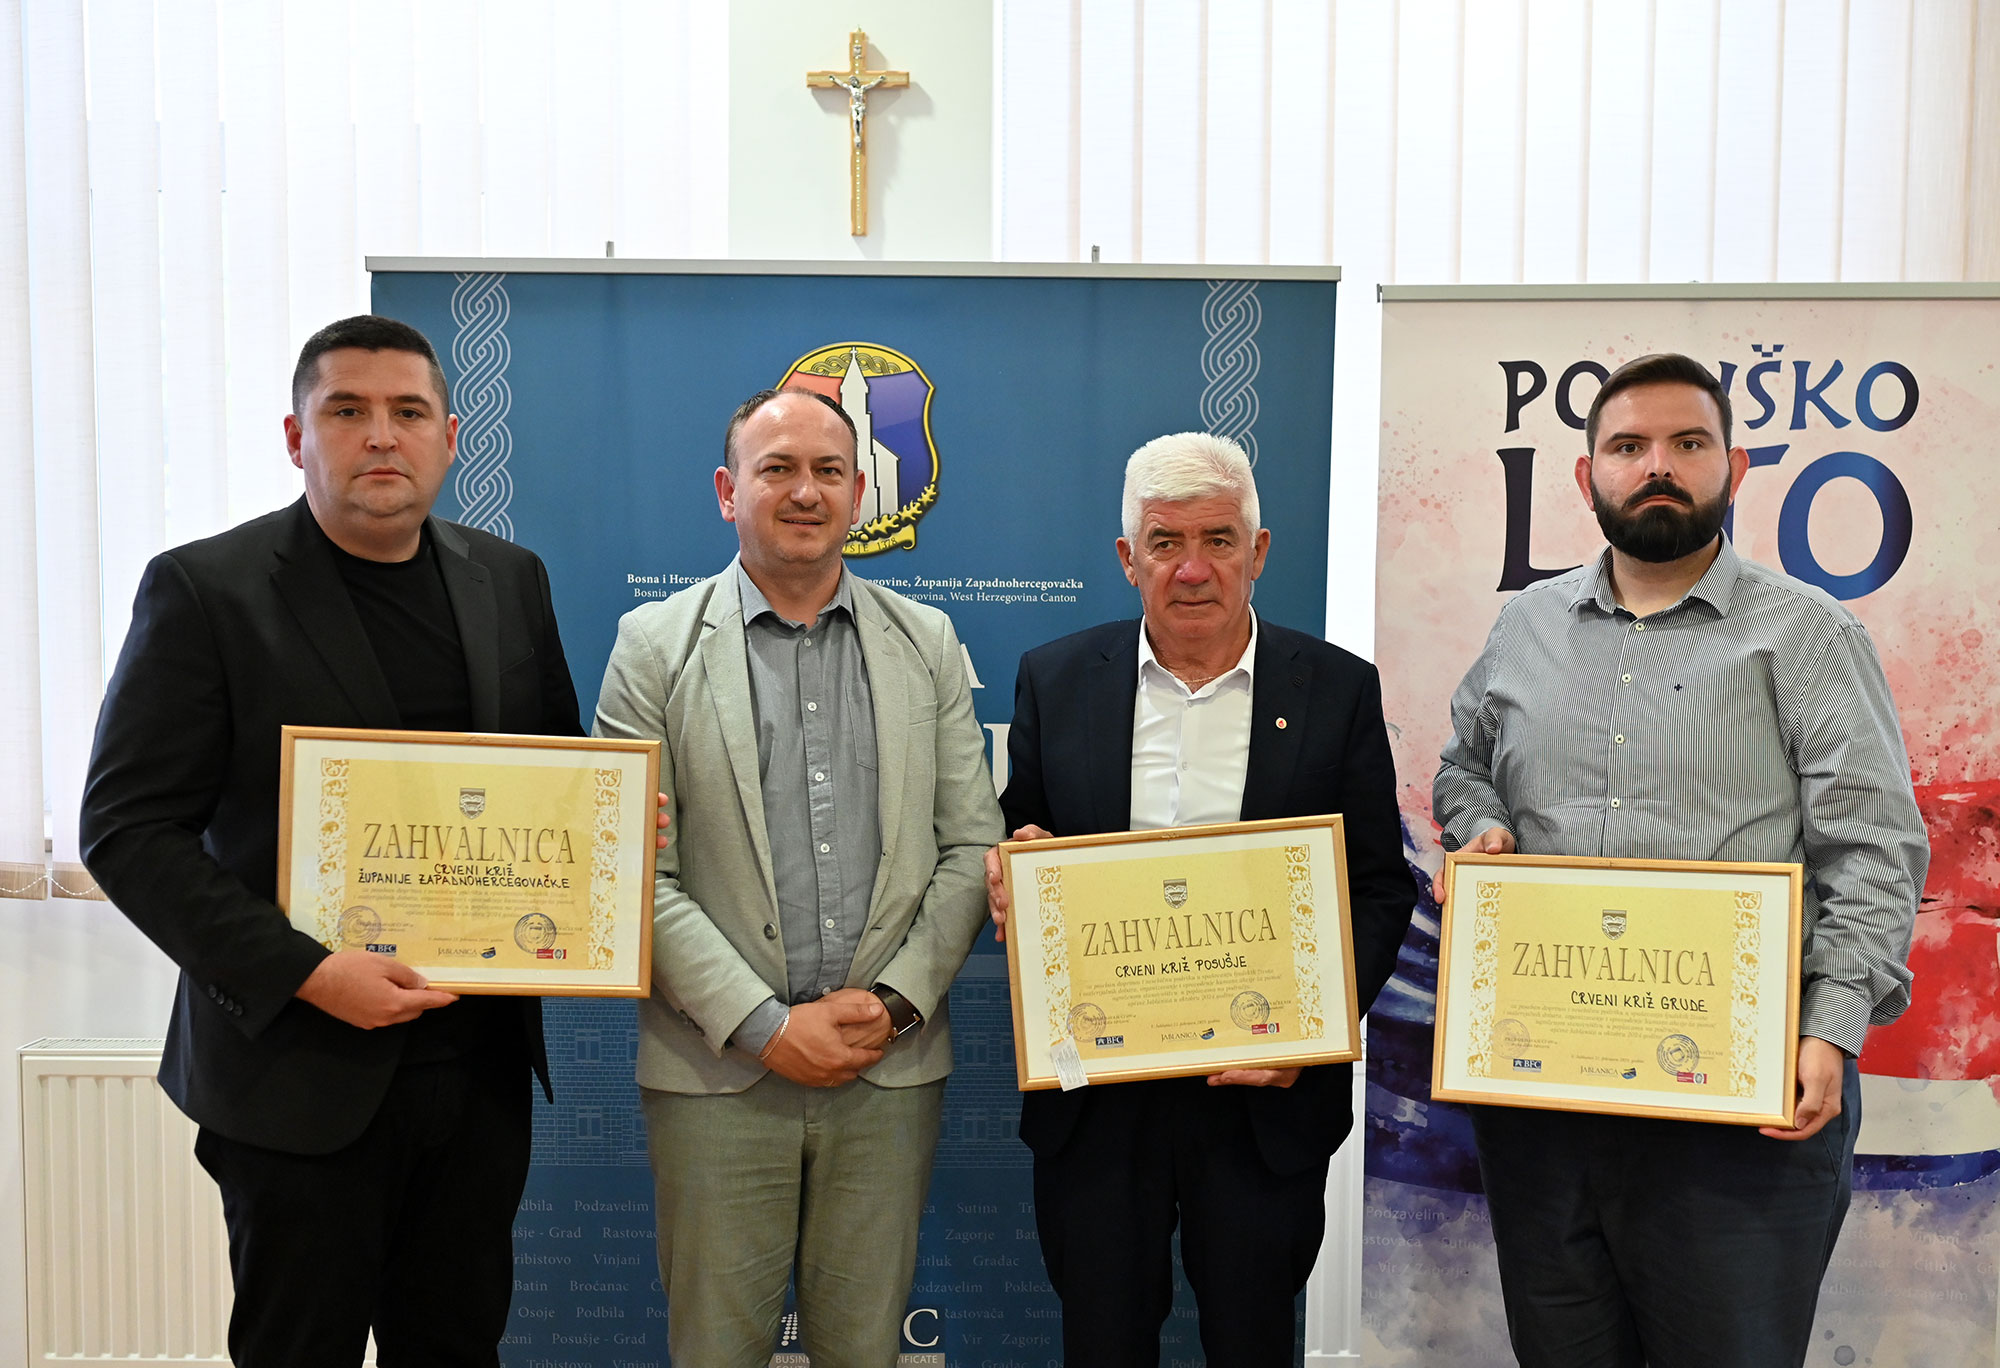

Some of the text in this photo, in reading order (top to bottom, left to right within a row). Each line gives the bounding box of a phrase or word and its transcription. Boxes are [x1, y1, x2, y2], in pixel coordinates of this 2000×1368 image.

[1499, 344, 1919, 433] POŠKO
[877, 537, 898, 550] 1378
[627, 574, 659, 584] Bosna
[663, 574, 666, 584] i
[914, 575, 962, 589] Županija
[965, 577, 1084, 591] Zapadnohercegovačka
[634, 588, 667, 597] Bosnia
[950, 592, 974, 601] West
[977, 592, 1038, 604] Herzegovina
[1041, 593, 1077, 602] Canton
[363, 823, 576, 864] ZAHVALNICA
[434, 863, 515, 877] CRVENI KRIŽ
[358, 868, 571, 889] ŽUPANIJE ZAPADNOHERCEGOVAČKE
[1081, 907, 1277, 957] ZAHVALNICA
[1115, 953, 1247, 978] CRVENI KRIŽ POSUŠJE
[1512, 942, 1715, 986] ZAHVALNICA
[1571, 990, 1708, 1013] CRVENI KRIŽ GRUDE
[574, 1200, 649, 1212] Podzavelim
[957, 1202, 998, 1214] Sutina
[1366, 1205, 1446, 1221] Podzavelim
[549, 1226, 582, 1239] Grad
[944, 1228, 995, 1243] Zagorje
[1016, 1228, 1040, 1240] Bat
[512, 1253, 571, 1265] ribistovo
[593, 1253, 640, 1268] Vinjani
[972, 1254, 1020, 1267] Gradac
[514, 1279, 548, 1291] Batin
[1005, 1281, 1055, 1293] Pokleča
[518, 1306, 556, 1320] Osoje
[576, 1306, 625, 1318] Podbila
[499, 1333, 532, 1345] ečani
[552, 1333, 600, 1347] Posušje
[613, 1333, 646, 1345] Grad
[962, 1334, 983, 1345] Vir
[1001, 1333, 1053, 1348] Zagorje
